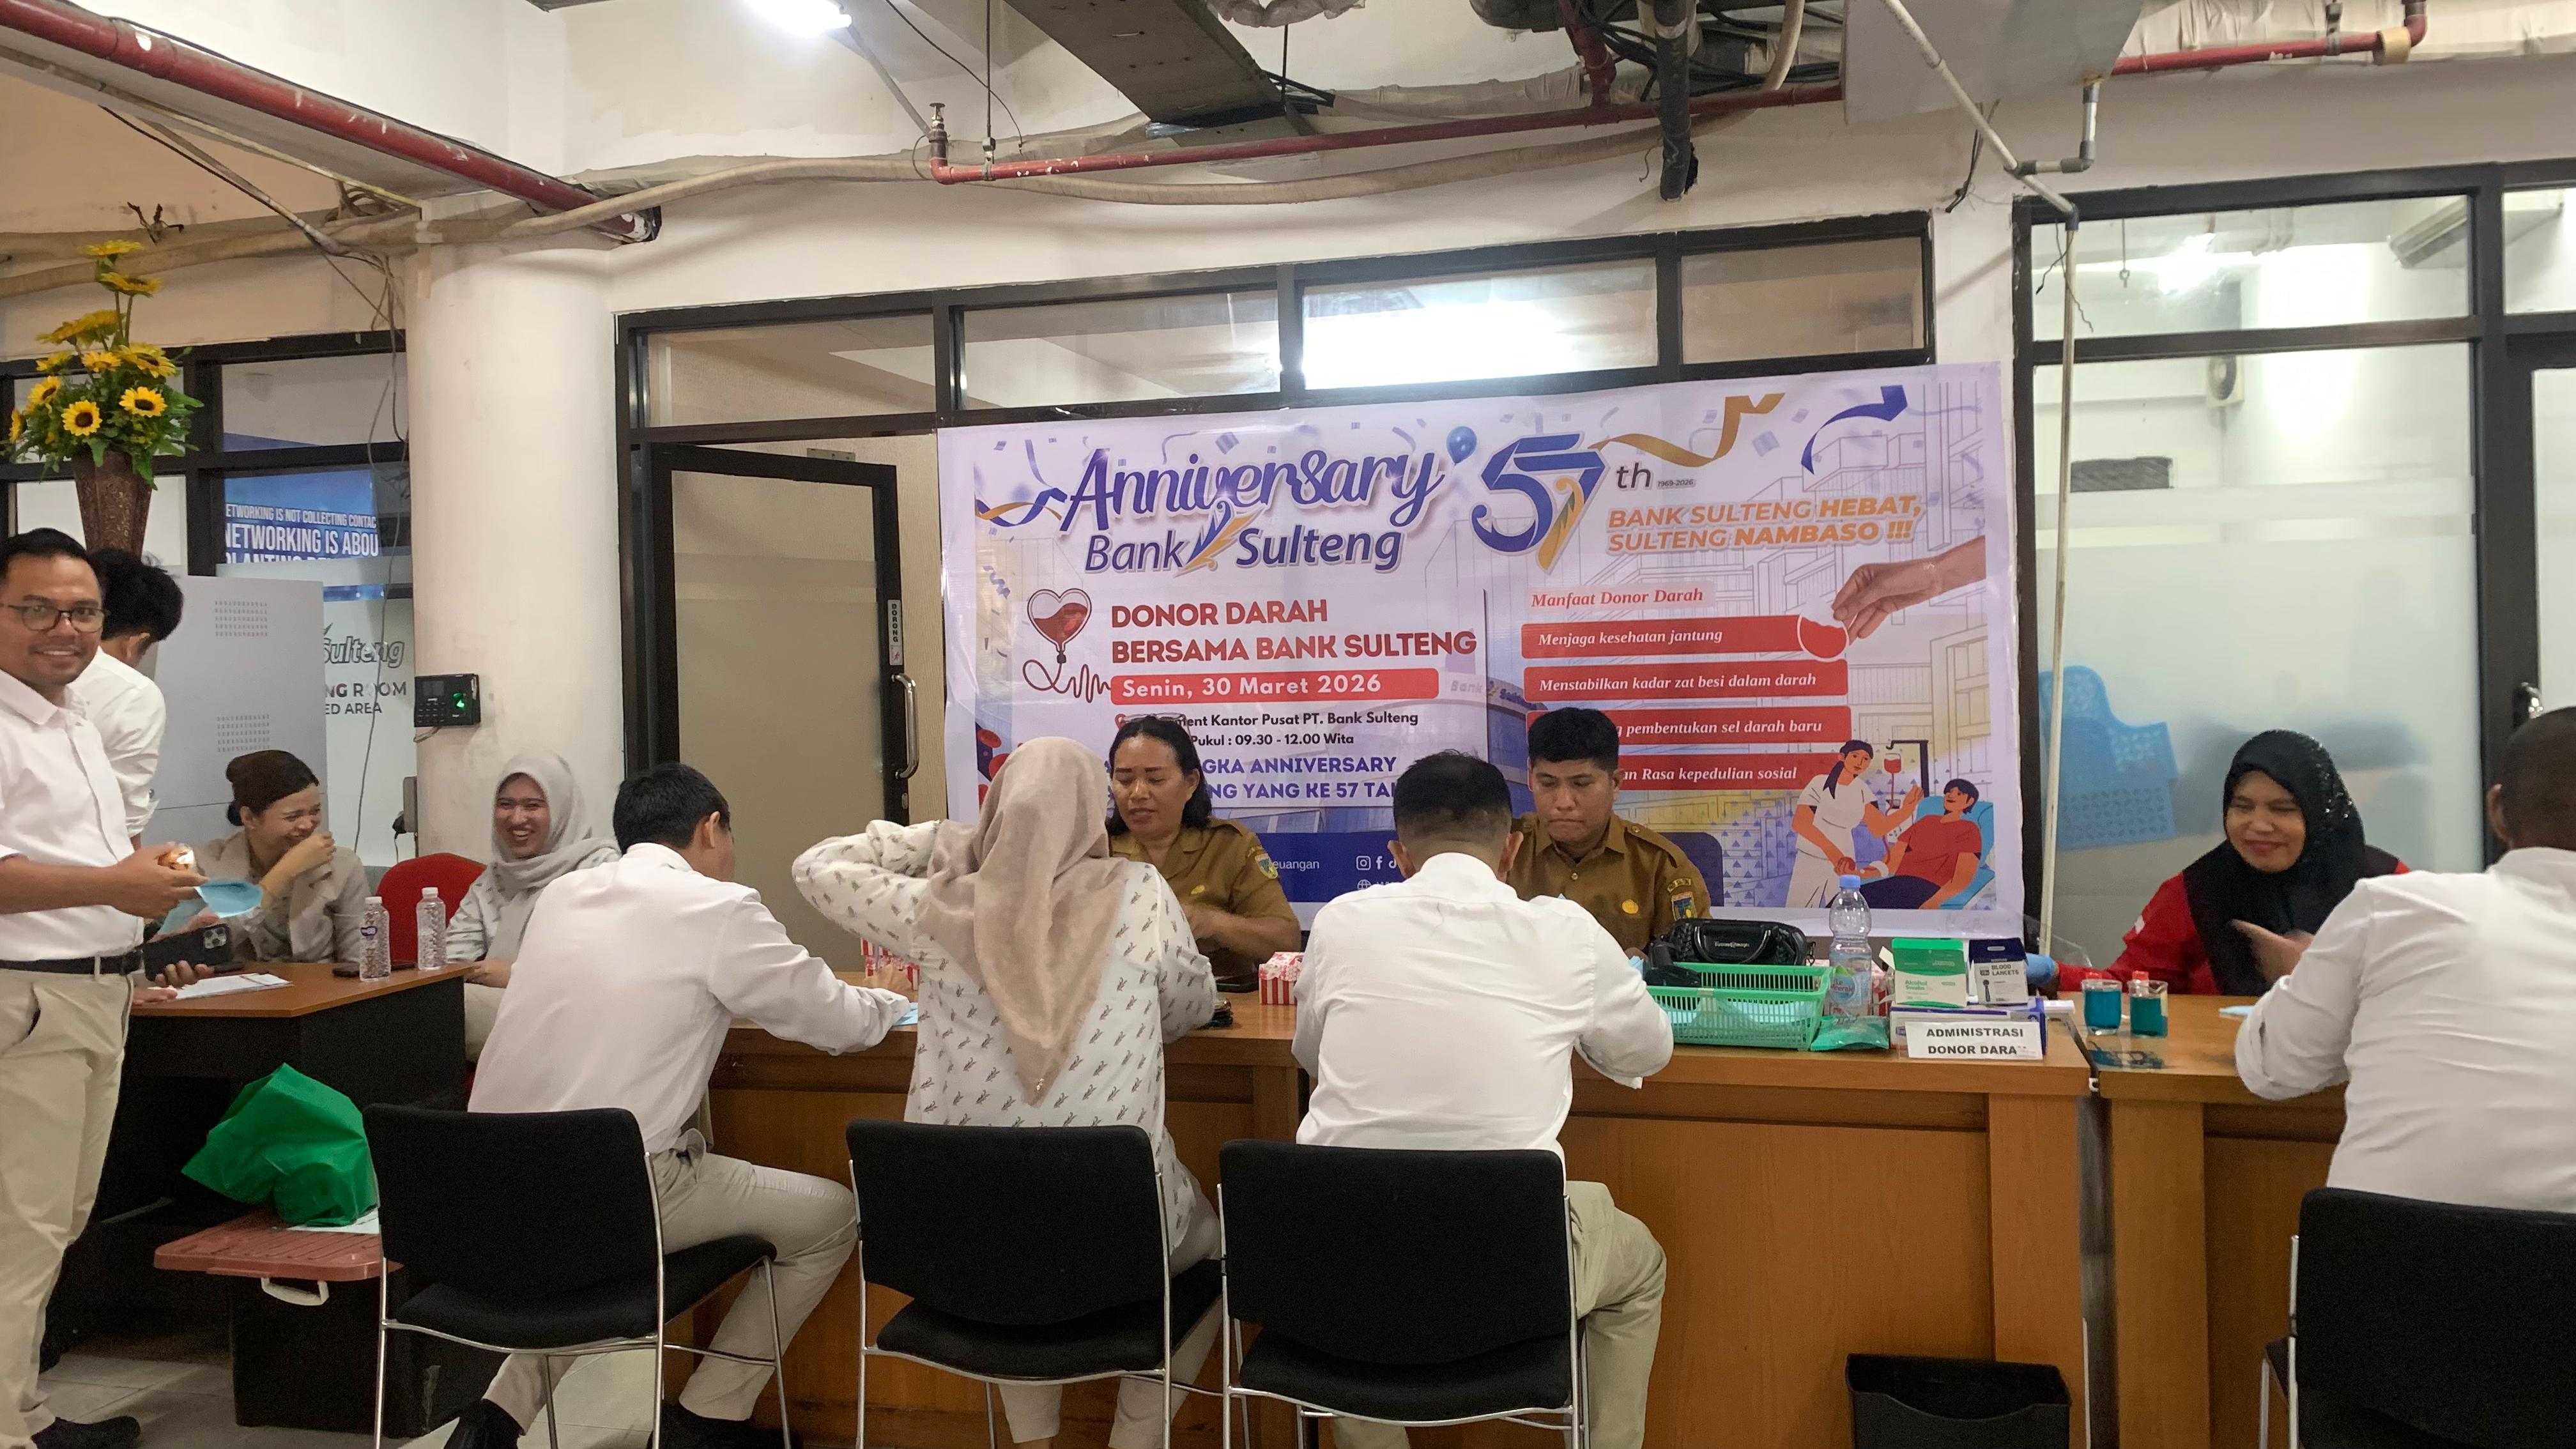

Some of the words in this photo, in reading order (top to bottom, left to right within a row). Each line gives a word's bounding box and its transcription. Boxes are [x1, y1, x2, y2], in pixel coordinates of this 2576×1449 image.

[226, 503, 274, 521] ETWORKING
[275, 508, 284, 521] IS
[285, 509, 300, 523] NOT
[303, 510, 347, 526] COLLECTING
[349, 514, 377, 529] CONTAC
[1609, 507, 1685, 528] BANK
[1689, 500, 1812, 524] SULTENG
[1819, 495, 1921, 518] HEBAT,
[325, 530, 339, 554] IS
[342, 531, 379, 557] ABOU
[1608, 528, 1727, 551] SULTENG
[1734, 521, 1879, 546] NAMBASO
[1085, 530, 1184, 571] Bank
[1236, 525, 1404, 571] Sulteng
[1531, 592, 1595, 609] Manfaat
[1600, 591, 1649, 604] Donor
[1653, 588, 1703, 603] Darah
[1112, 603, 1218, 627] DONOR
[1226, 599, 1328, 625] DARAH
[1112, 638, 1250, 663] BERSAMA
[1256, 635, 1338, 660] BANK
[1344, 631, 1477, 658] SULTENG
[1538, 632, 1595, 648] Menjaga
[1599, 631, 1666, 644] kesehatan
[1668, 629, 1723, 645] jantung
[1122, 679, 1193, 700] Senin,
[1202, 677, 1231, 695] 30
[1239, 677, 1308, 695] Maret
[1317, 674, 1381, 694] 2026
[1539, 678, 1629, 692] Menstabilkan
[1632, 676, 1671, 689] kadar
[1675, 677, 1694, 689] zat
[1698, 675, 1725, 687] besi
[1728, 675, 1771, 687] dalam
[1775, 673, 1816, 686] darah
[344, 702, 383, 714] AREA
[1211, 714, 1259, 726] Kantor
[1262, 713, 1300, 726] Pusat
[1303, 713, 1324, 724] PT.
[1328, 712, 1363, 724] Bank
[1366, 711, 1418, 726] Sulteng
[1627, 721, 1717, 737] pembentukan
[1722, 721, 1740, 733] sel
[1744, 720, 1784, 733] darah
[1790, 720, 1822, 732] baru
[1235, 735, 1273, 746] 09.30
[1285, 734, 1321, 745] 12.00
[1324, 733, 1354, 744] Wita
[1250, 756, 1397, 774] ANNIVERSARY
[1642, 769, 1675, 780] Rasa
[1678, 767, 1754, 783] kepedulian
[1757, 767, 1798, 779] sosial
[1243, 783, 1300, 799] YANG
[1306, 783, 1331, 798] KE
[1336, 783, 1359, 798] 57
[1274, 861, 1320, 871] euangan
[1926, 1027, 2023, 1038] ADMINISTRASI
[1928, 1045, 1976, 1054] DONOR
[1981, 1045, 2027, 1054] DARA
